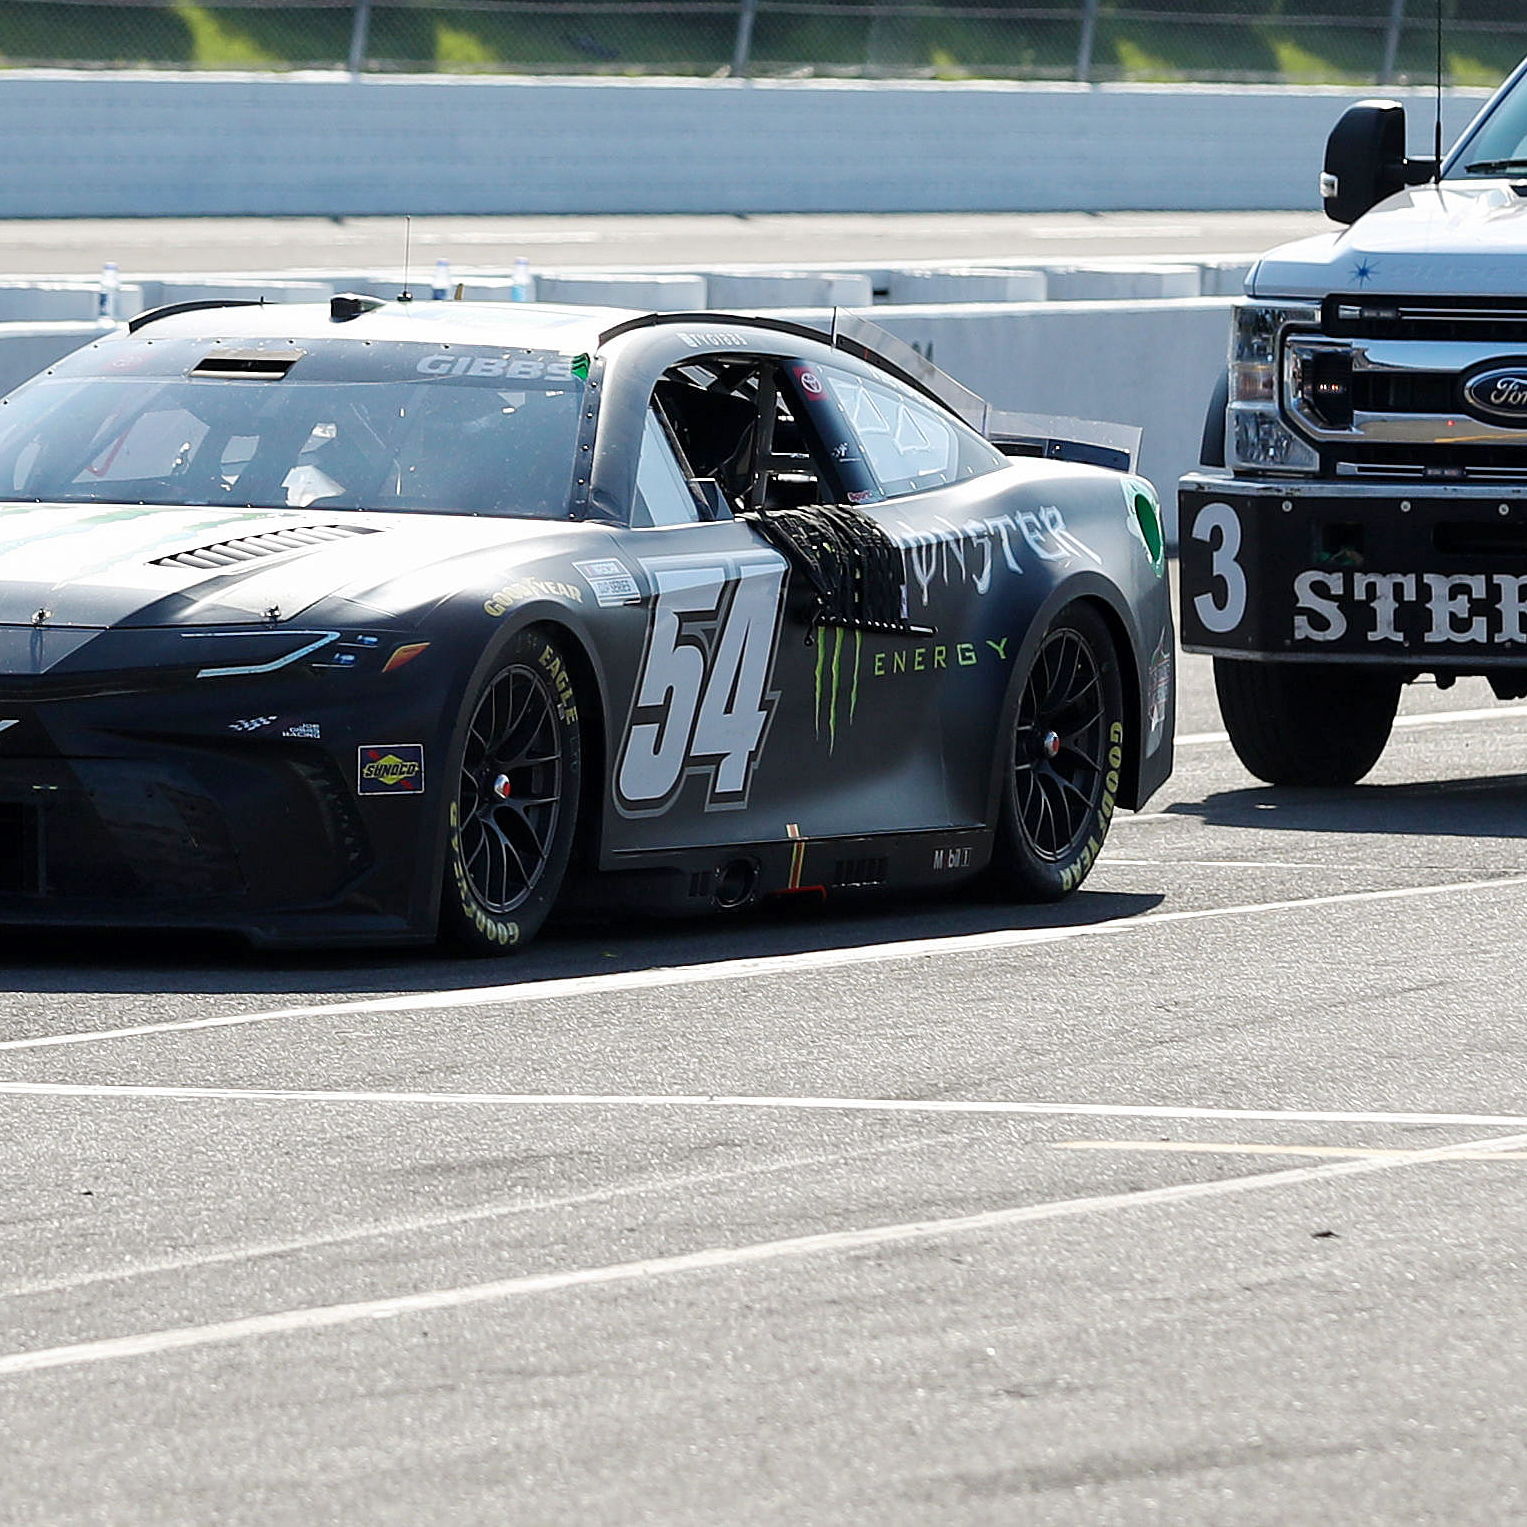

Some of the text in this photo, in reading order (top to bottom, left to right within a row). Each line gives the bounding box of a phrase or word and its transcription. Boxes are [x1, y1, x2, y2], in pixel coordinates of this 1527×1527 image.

[416, 354, 574, 382] GIBBS
[898, 505, 1103, 607] ONSTER
[1191, 501, 1248, 635] 3
[483, 576, 584, 618] GOODYEAR
[538, 645, 579, 726] EAGLE
[617, 560, 785, 802] 54
[874, 637, 1010, 676] ENERGY
[366, 761, 417, 778] SUNOCO
[1058, 721, 1123, 891] GOODYEAR
[933, 848, 961, 870] Mbil
